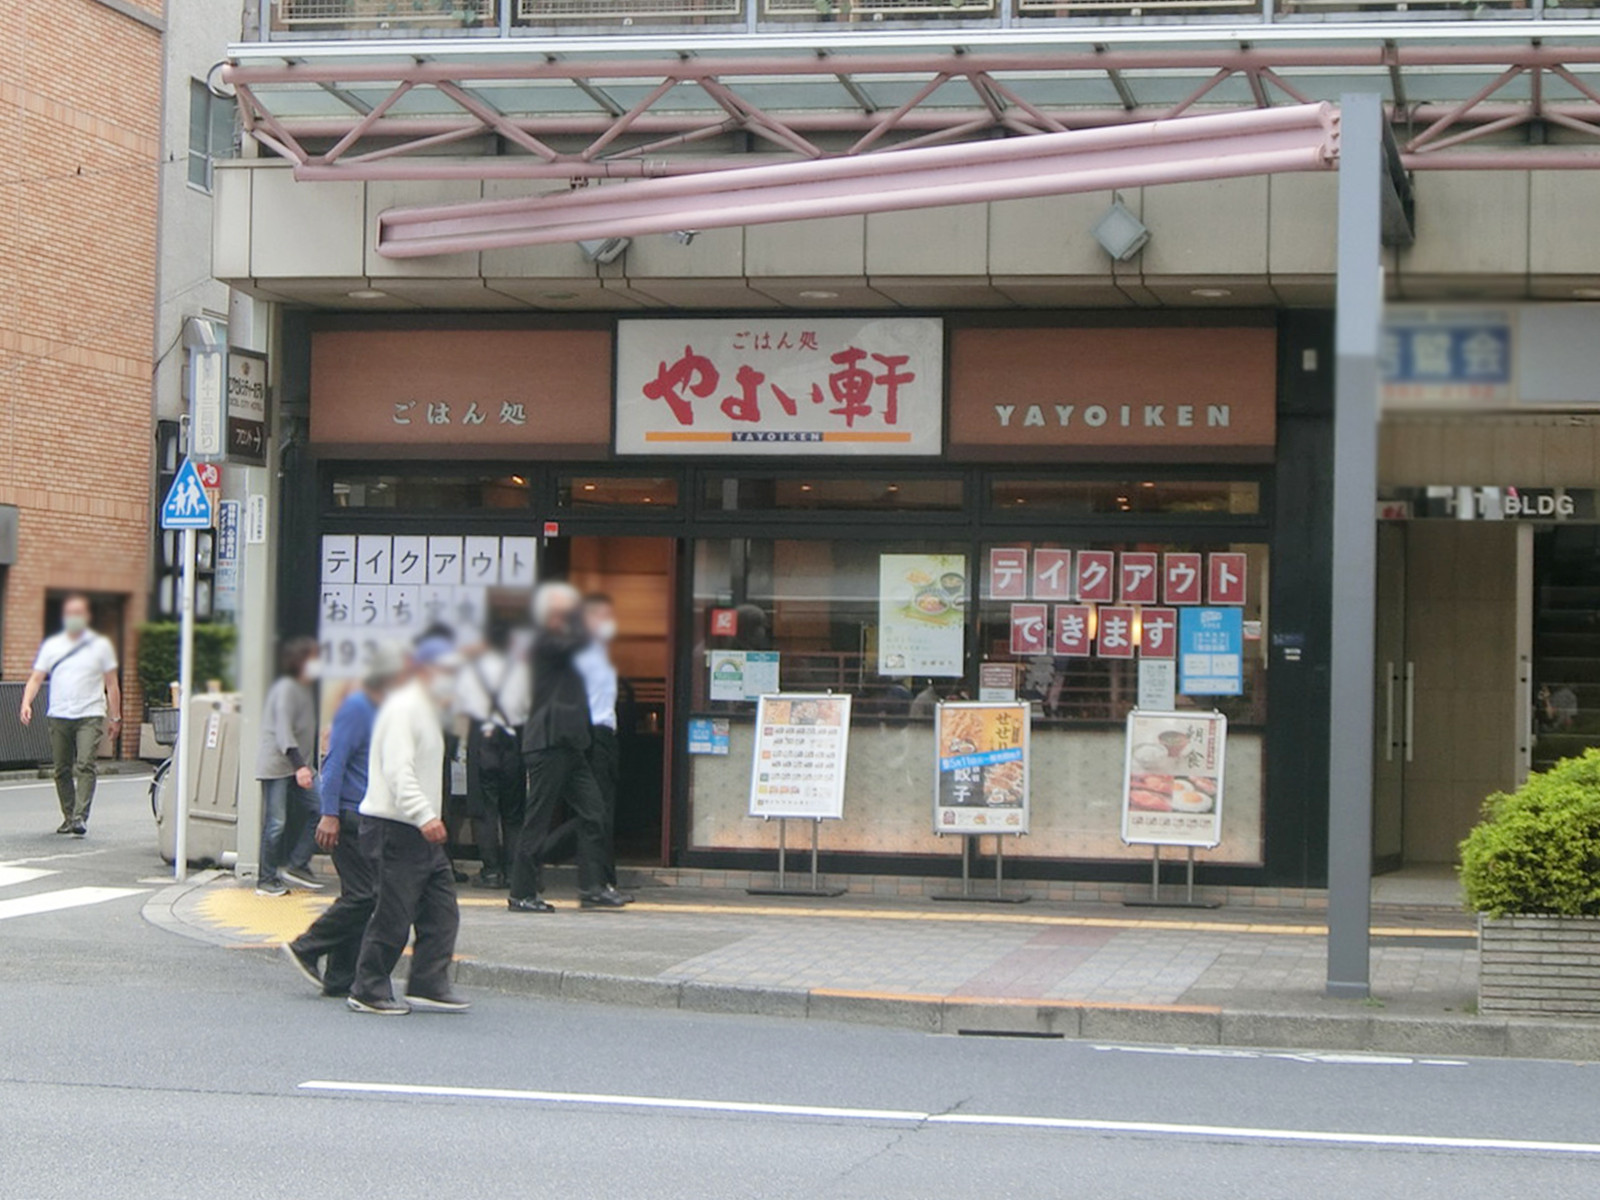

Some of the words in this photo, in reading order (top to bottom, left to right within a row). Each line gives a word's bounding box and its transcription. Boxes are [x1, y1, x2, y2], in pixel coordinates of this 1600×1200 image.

[731, 330, 819, 352] ごはん処
[643, 345, 915, 428] やよい軒
[392, 401, 526, 425] ごはん処
[995, 405, 1230, 427] YAYOIKEN
[734, 431, 822, 442] YAYOIKEN
[1505, 495, 1574, 515] BLDG
[327, 550, 525, 575] テイクアウト
[994, 560, 1239, 594] テイクアウト
[1014, 615, 1173, 648] できます
